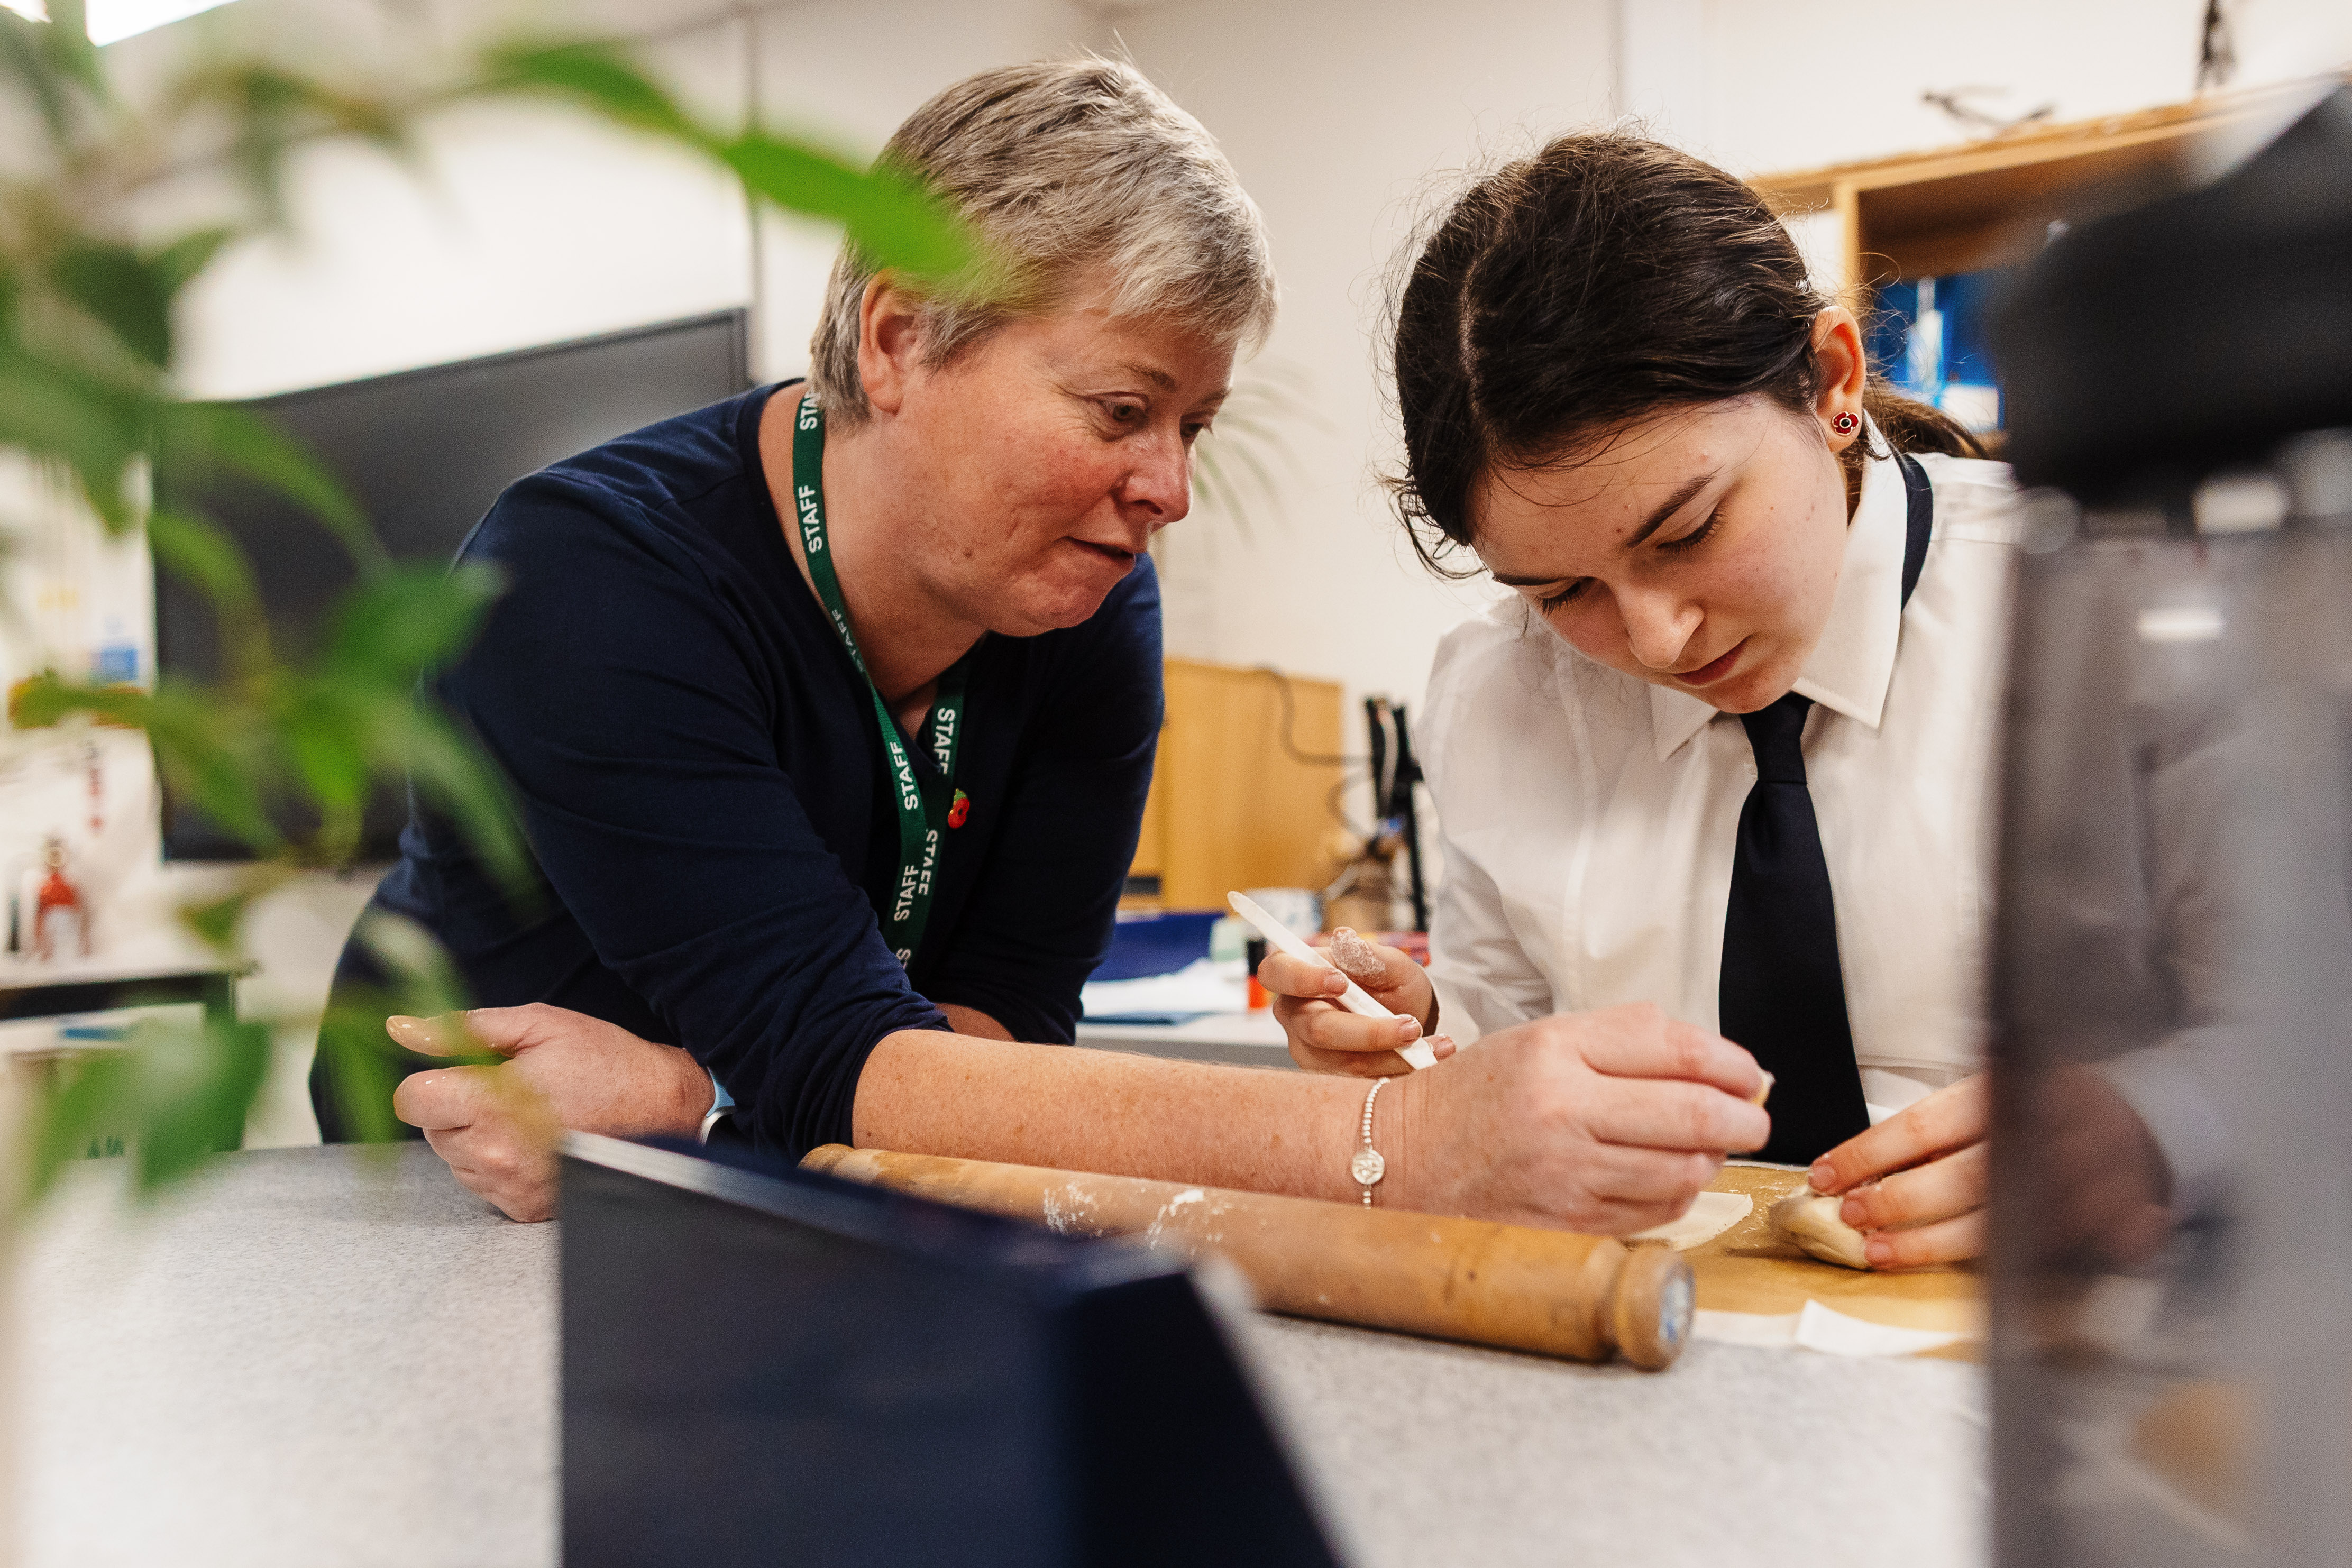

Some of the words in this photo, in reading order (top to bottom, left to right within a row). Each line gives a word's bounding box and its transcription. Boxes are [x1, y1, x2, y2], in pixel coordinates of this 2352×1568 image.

[799, 485, 822, 553] STAFF
[890, 741, 919, 810] STAFF
[894, 865, 919, 921] STAFF
